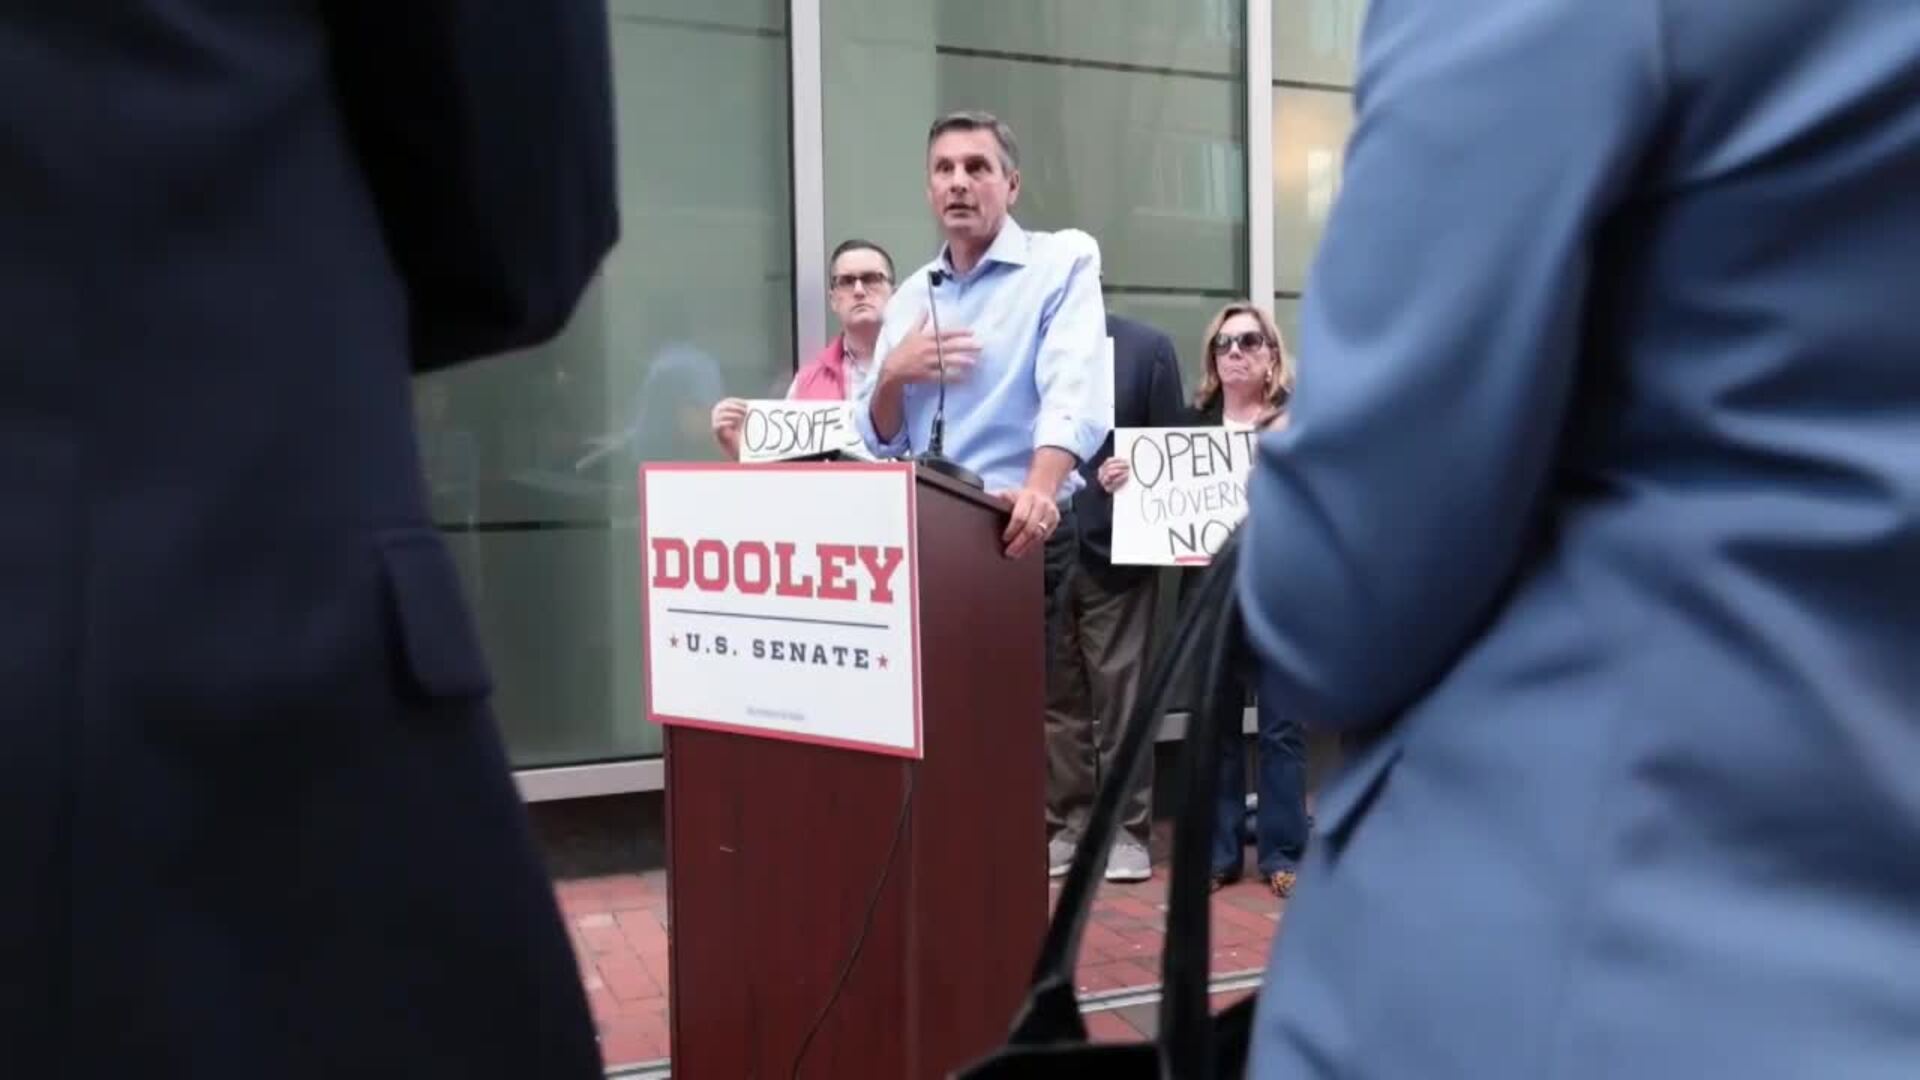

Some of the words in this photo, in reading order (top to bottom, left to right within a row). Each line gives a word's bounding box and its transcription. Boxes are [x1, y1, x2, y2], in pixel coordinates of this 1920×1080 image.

[1131, 432, 1232, 488] OPEN
[1168, 519, 1240, 556] NO
[651, 537, 903, 604] DOOLEY
[686, 633, 737, 656] U.S.
[753, 639, 869, 669] SENATE
